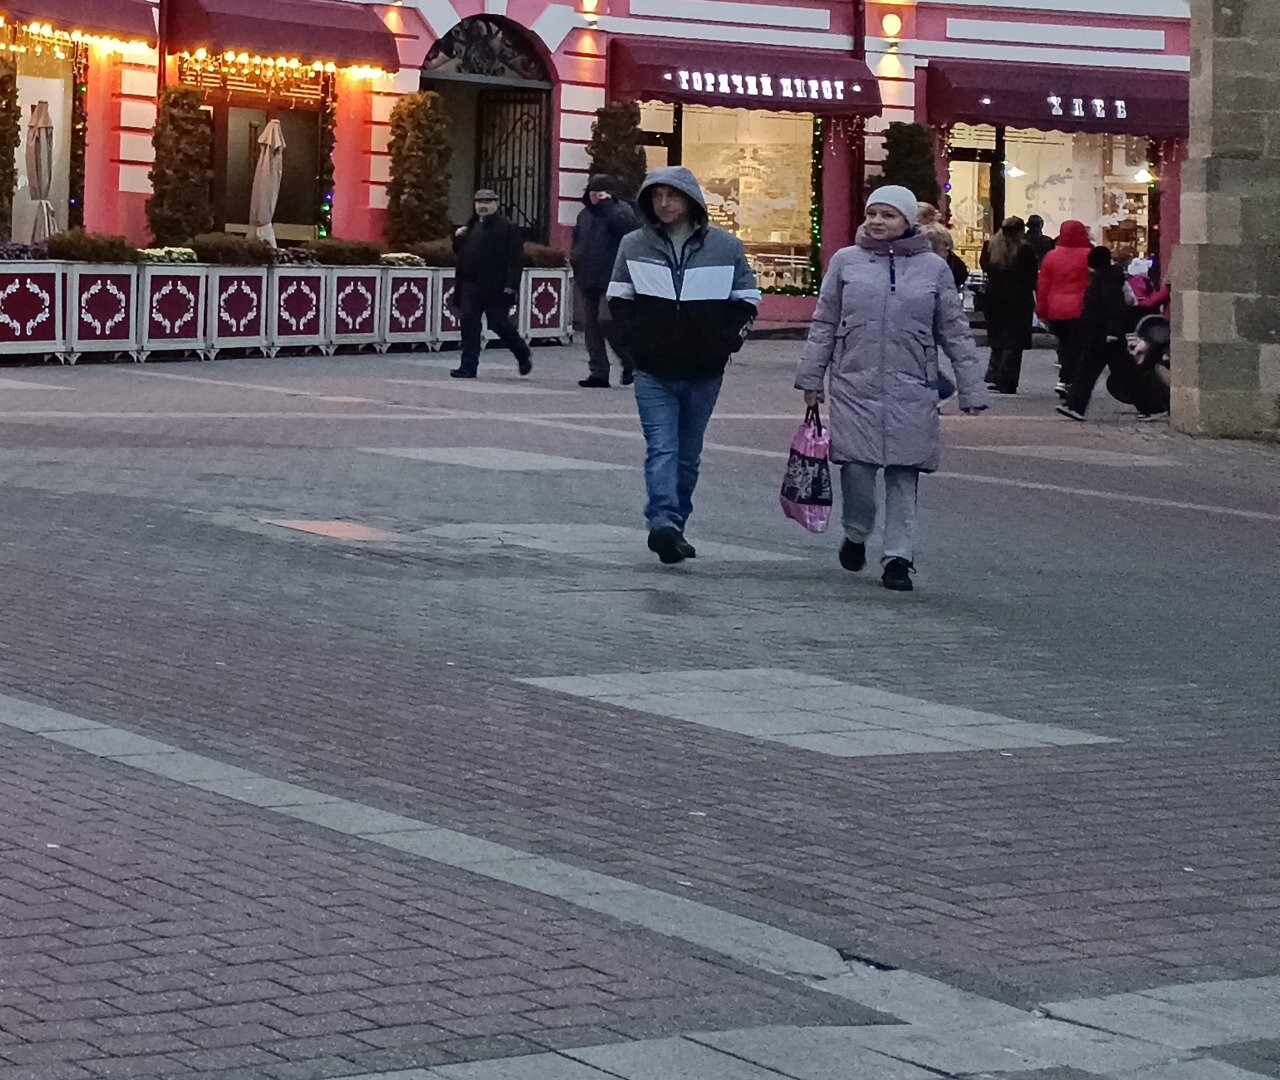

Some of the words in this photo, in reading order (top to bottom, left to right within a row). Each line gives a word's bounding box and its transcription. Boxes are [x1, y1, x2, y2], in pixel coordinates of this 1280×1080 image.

[678, 71, 773, 96] ГОРЯЧИЙ
[779, 77, 844, 100] ПИРОГ
[1047, 94, 1128, 119] ХЛЕБ
